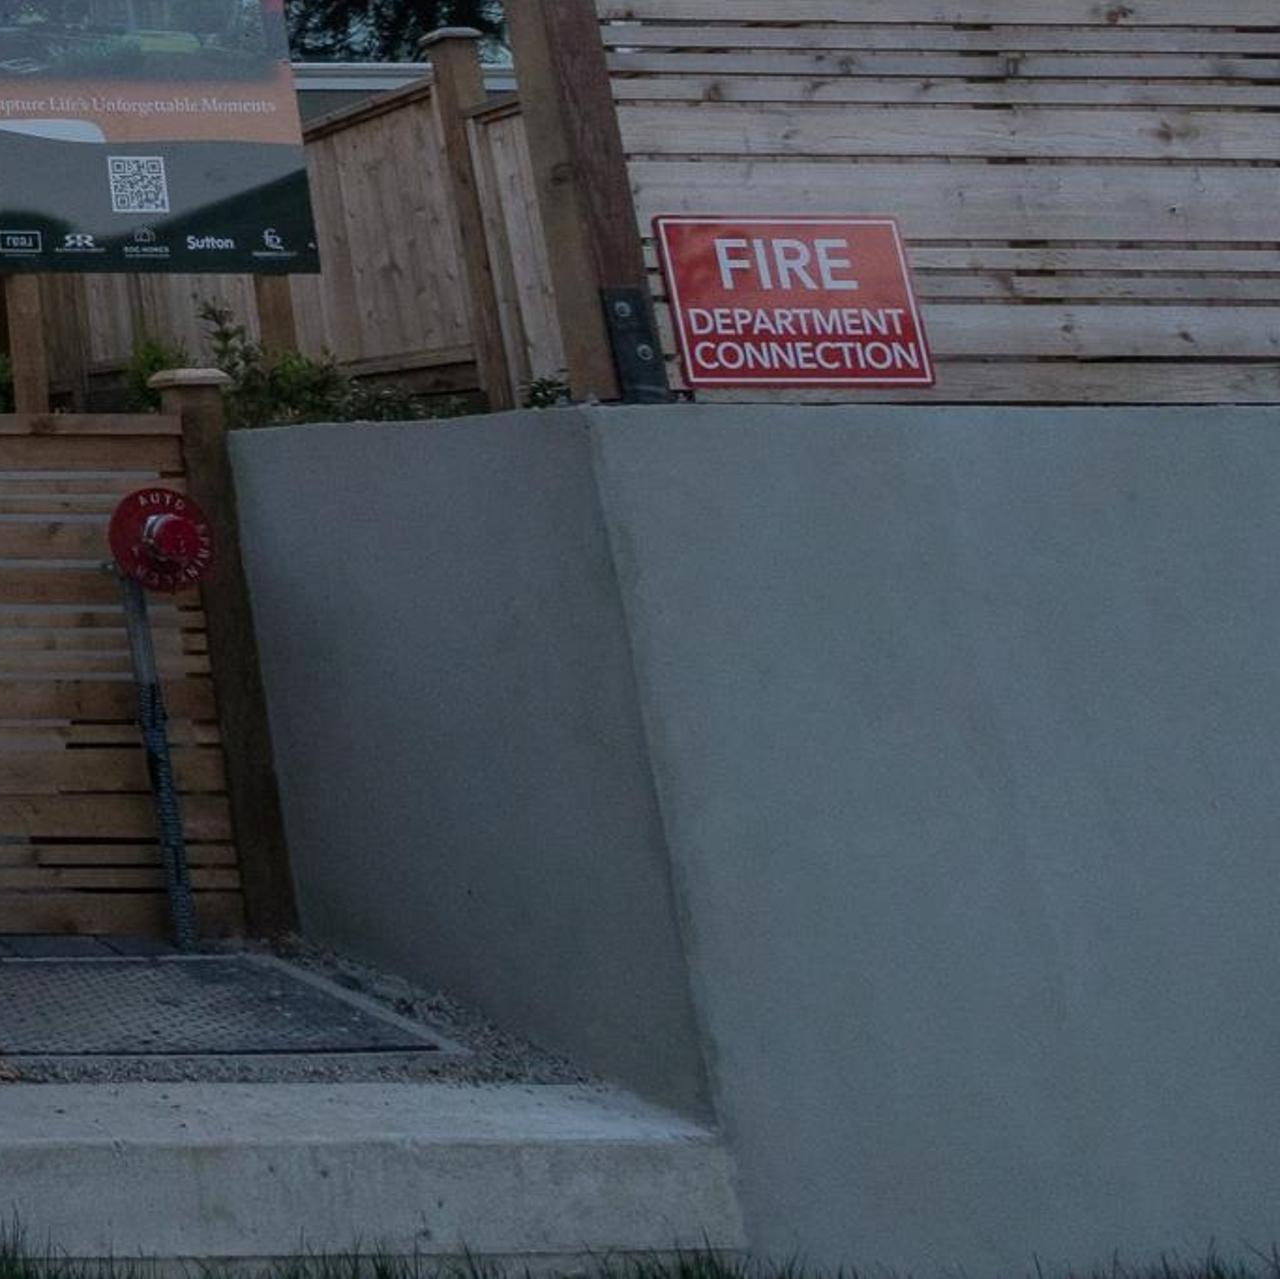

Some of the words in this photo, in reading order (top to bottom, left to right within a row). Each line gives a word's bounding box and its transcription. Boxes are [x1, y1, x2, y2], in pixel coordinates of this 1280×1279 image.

[92, 96, 197, 116] Unforgettable
[200, 97, 276, 113] Moments
[186, 235, 235, 250] Sutton
[713, 238, 859, 290] FIRE
[687, 308, 905, 336] DEPARTMENT
[694, 341, 920, 370] CONNECTION
[139, 492, 185, 510] AUTO
